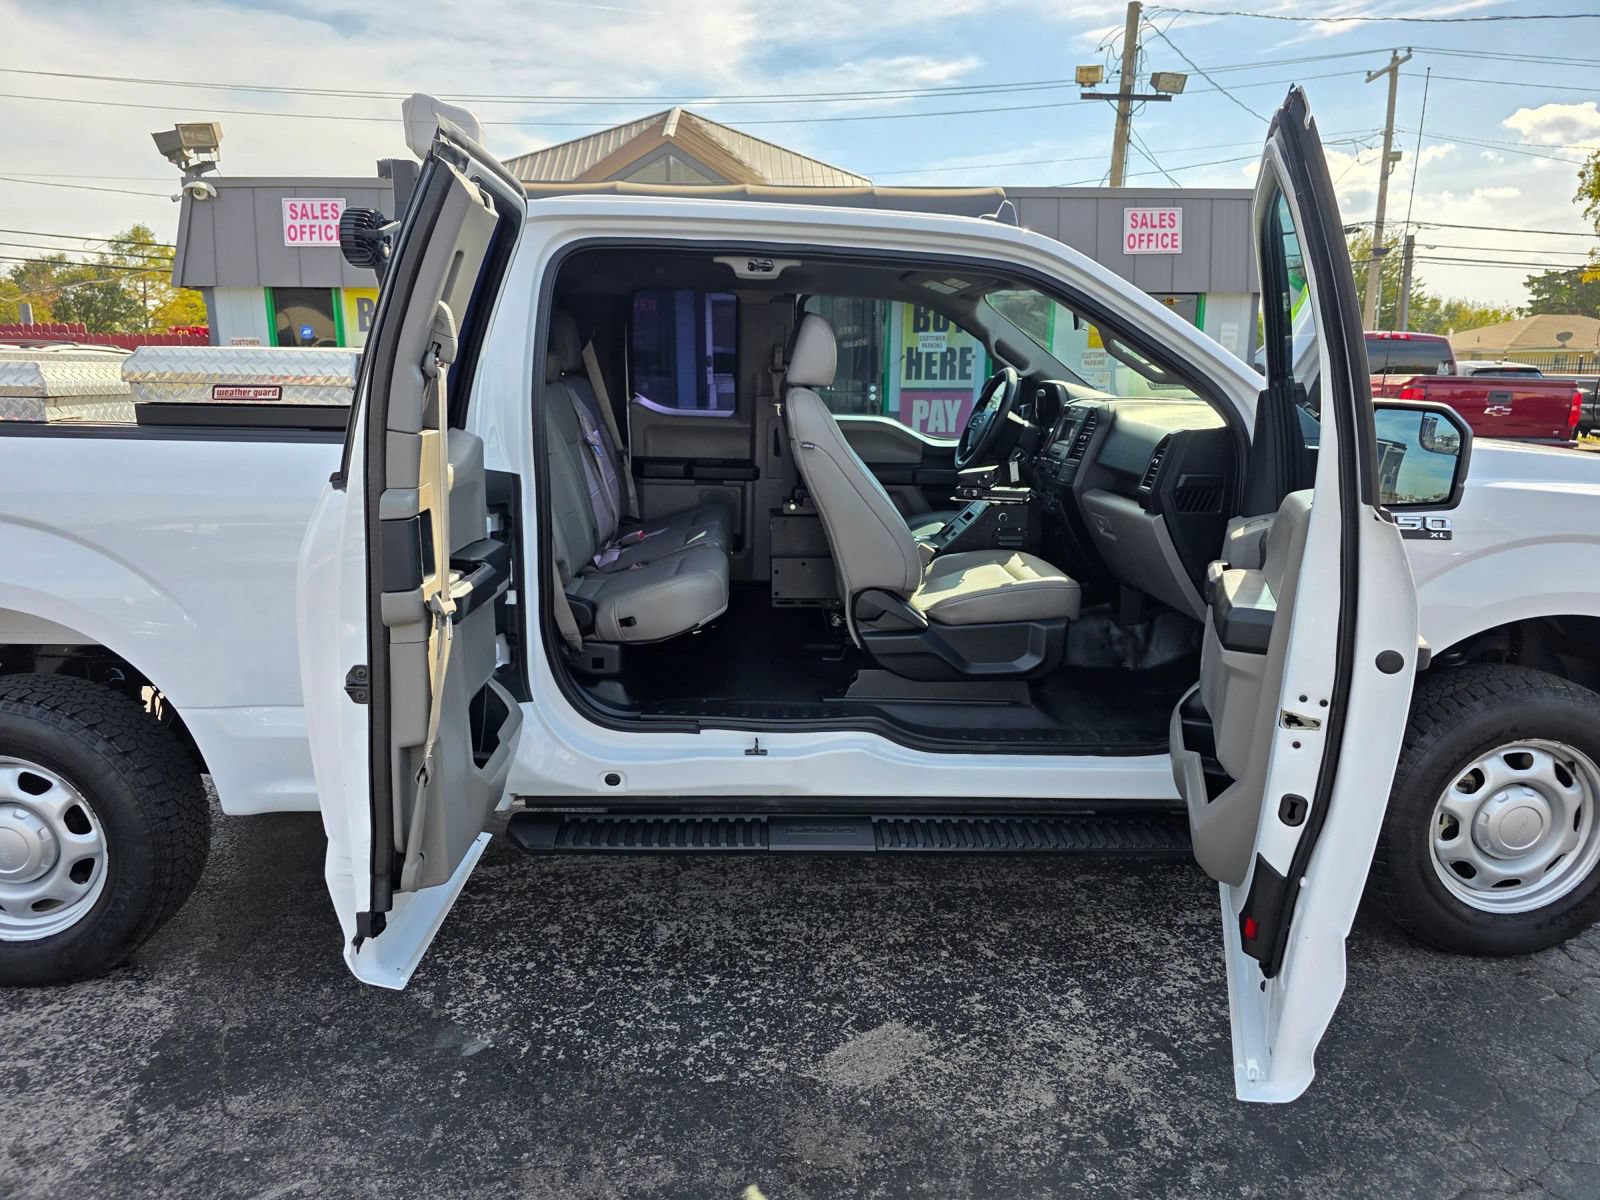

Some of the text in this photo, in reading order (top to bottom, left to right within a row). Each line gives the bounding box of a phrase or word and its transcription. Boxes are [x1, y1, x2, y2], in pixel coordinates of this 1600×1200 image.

[289, 203, 340, 220] SALES
[1130, 212, 1176, 229] SALES
[1127, 232, 1179, 250] OFFICE
[905, 347, 973, 381] HERE
[216, 389, 278, 398] weather guard
[912, 400, 962, 433] PAY
